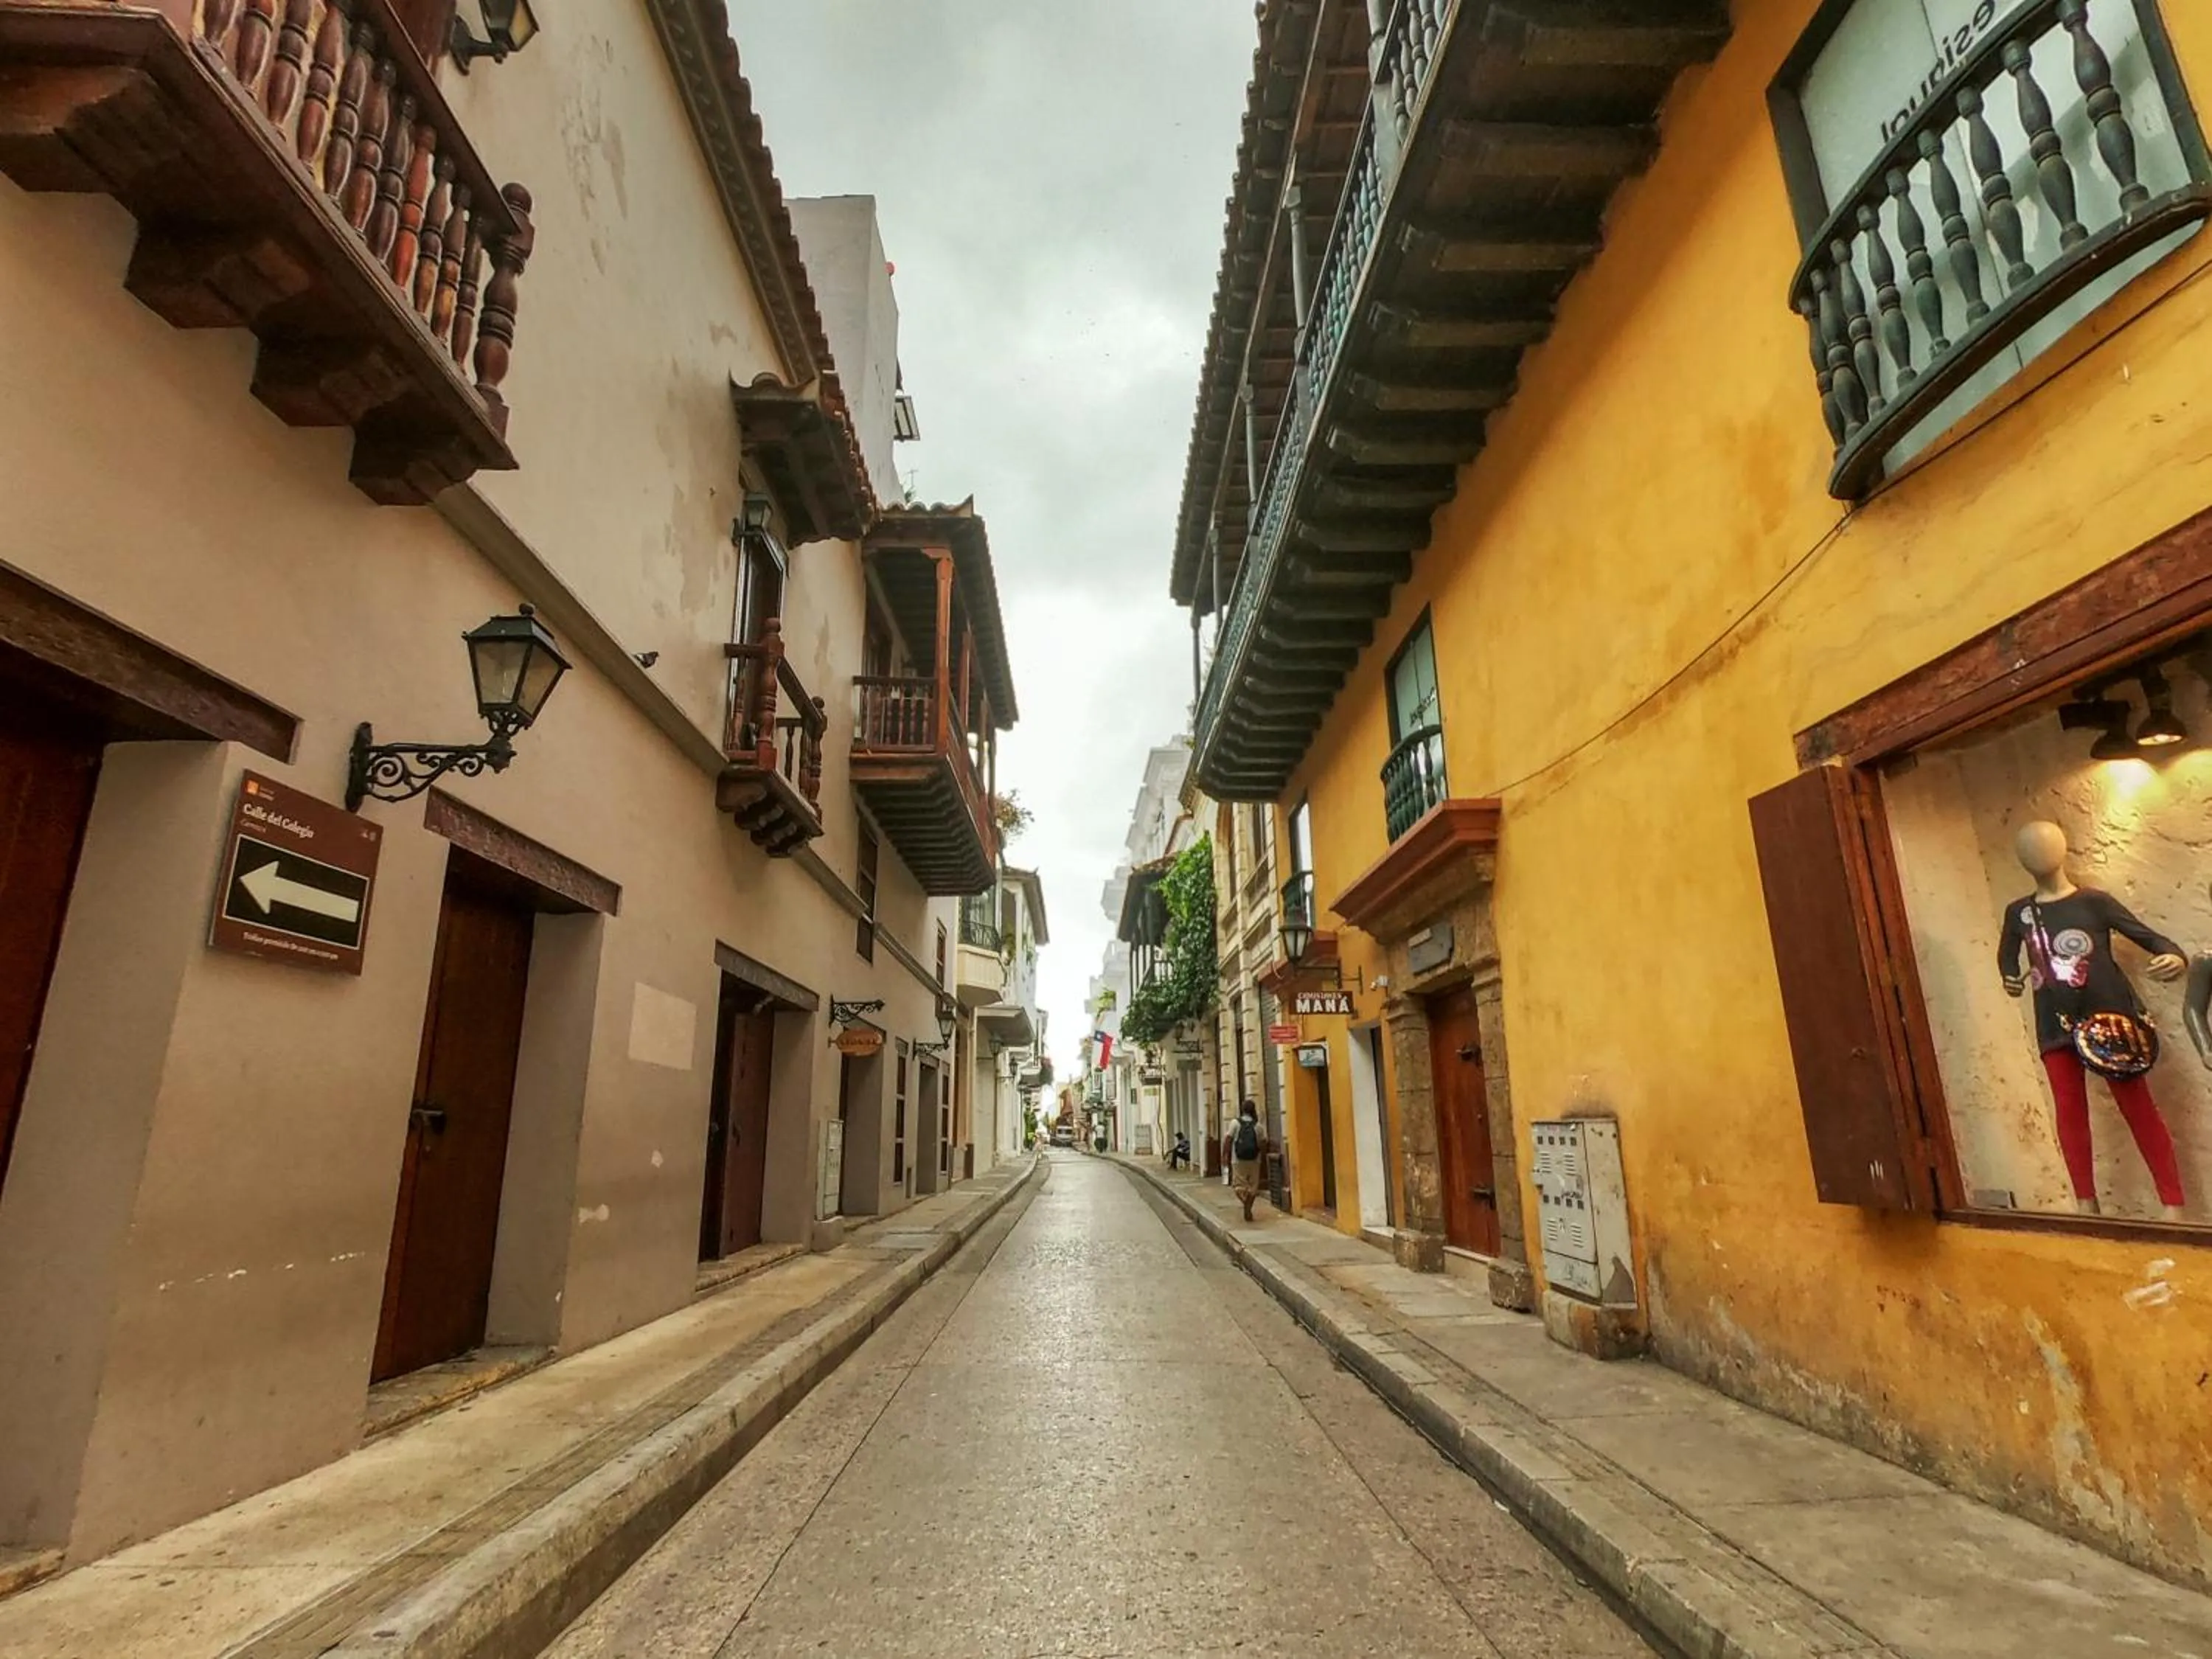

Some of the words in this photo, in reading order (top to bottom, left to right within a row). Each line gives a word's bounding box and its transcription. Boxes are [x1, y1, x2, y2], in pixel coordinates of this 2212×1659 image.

[243, 804, 267, 821] Calle
[268, 812, 282, 826] del
[282, 818, 314, 838] Colegio
[1295, 995, 1349, 1013] MANÁ
